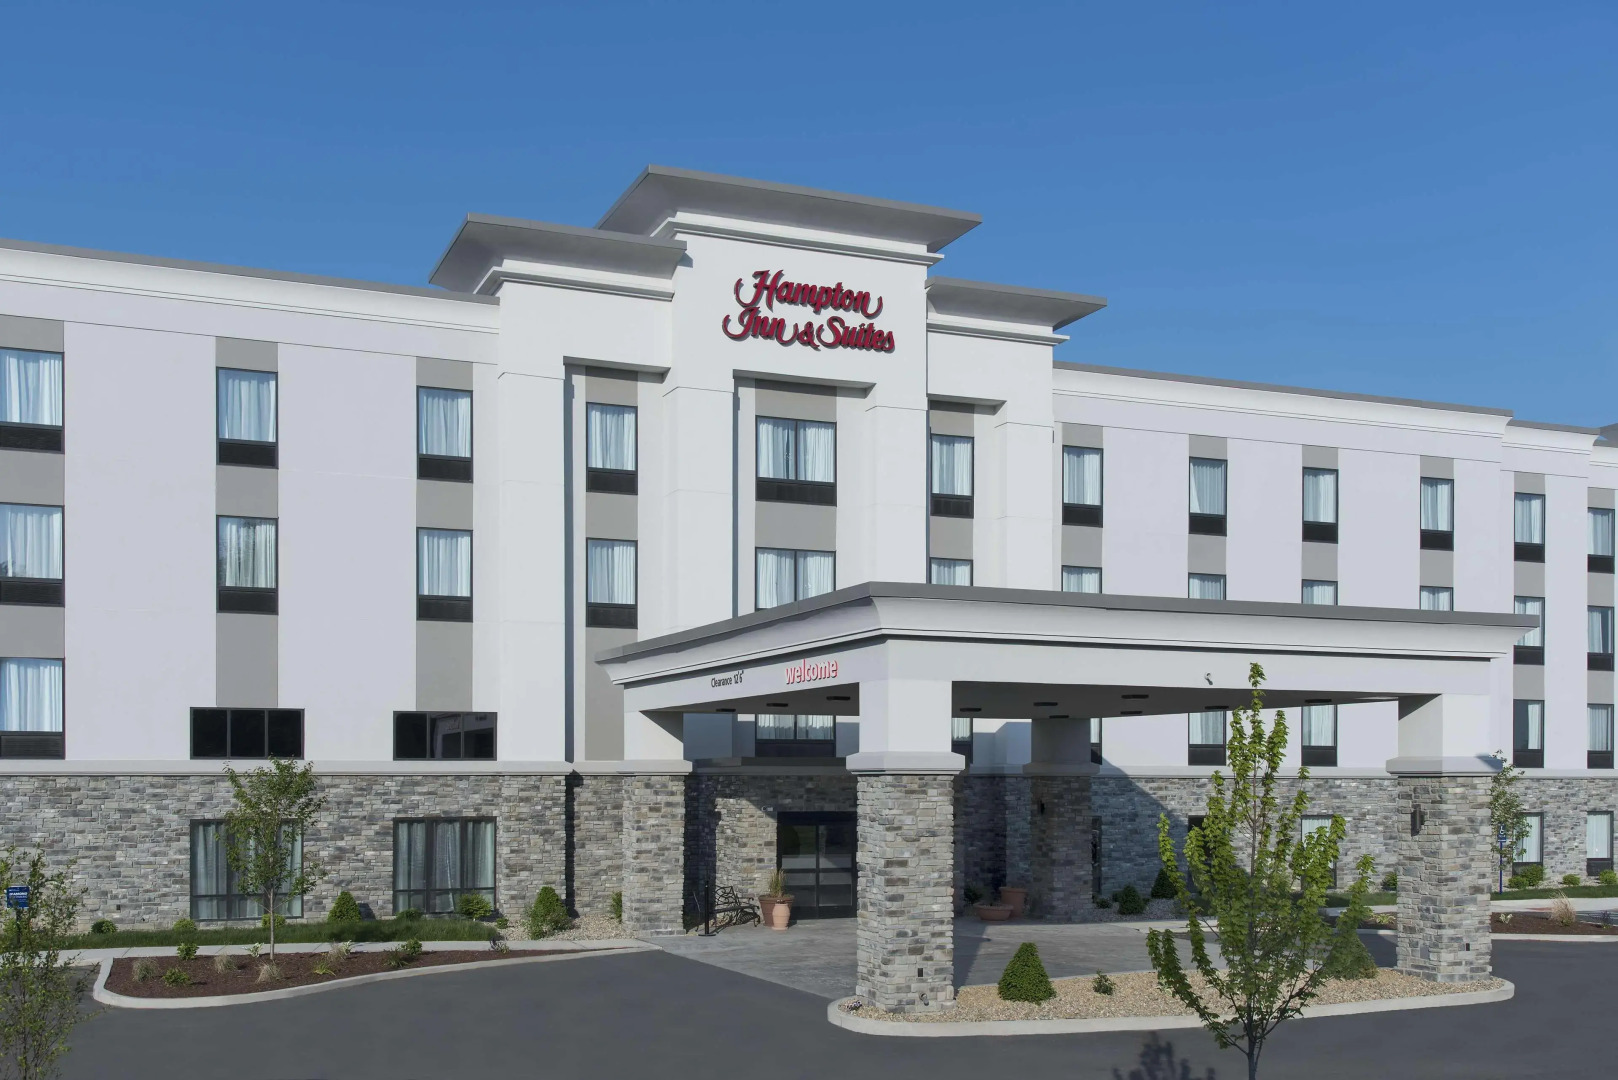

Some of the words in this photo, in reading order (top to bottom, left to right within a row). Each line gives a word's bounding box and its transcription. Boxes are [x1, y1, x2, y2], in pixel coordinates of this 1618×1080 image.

[734, 269, 883, 318] Hampton
[722, 306, 799, 344] Inn
[798, 321, 819, 349] &
[816, 316, 895, 352] Suites
[711, 677, 732, 688] Clearance
[786, 658, 839, 685] welcome
